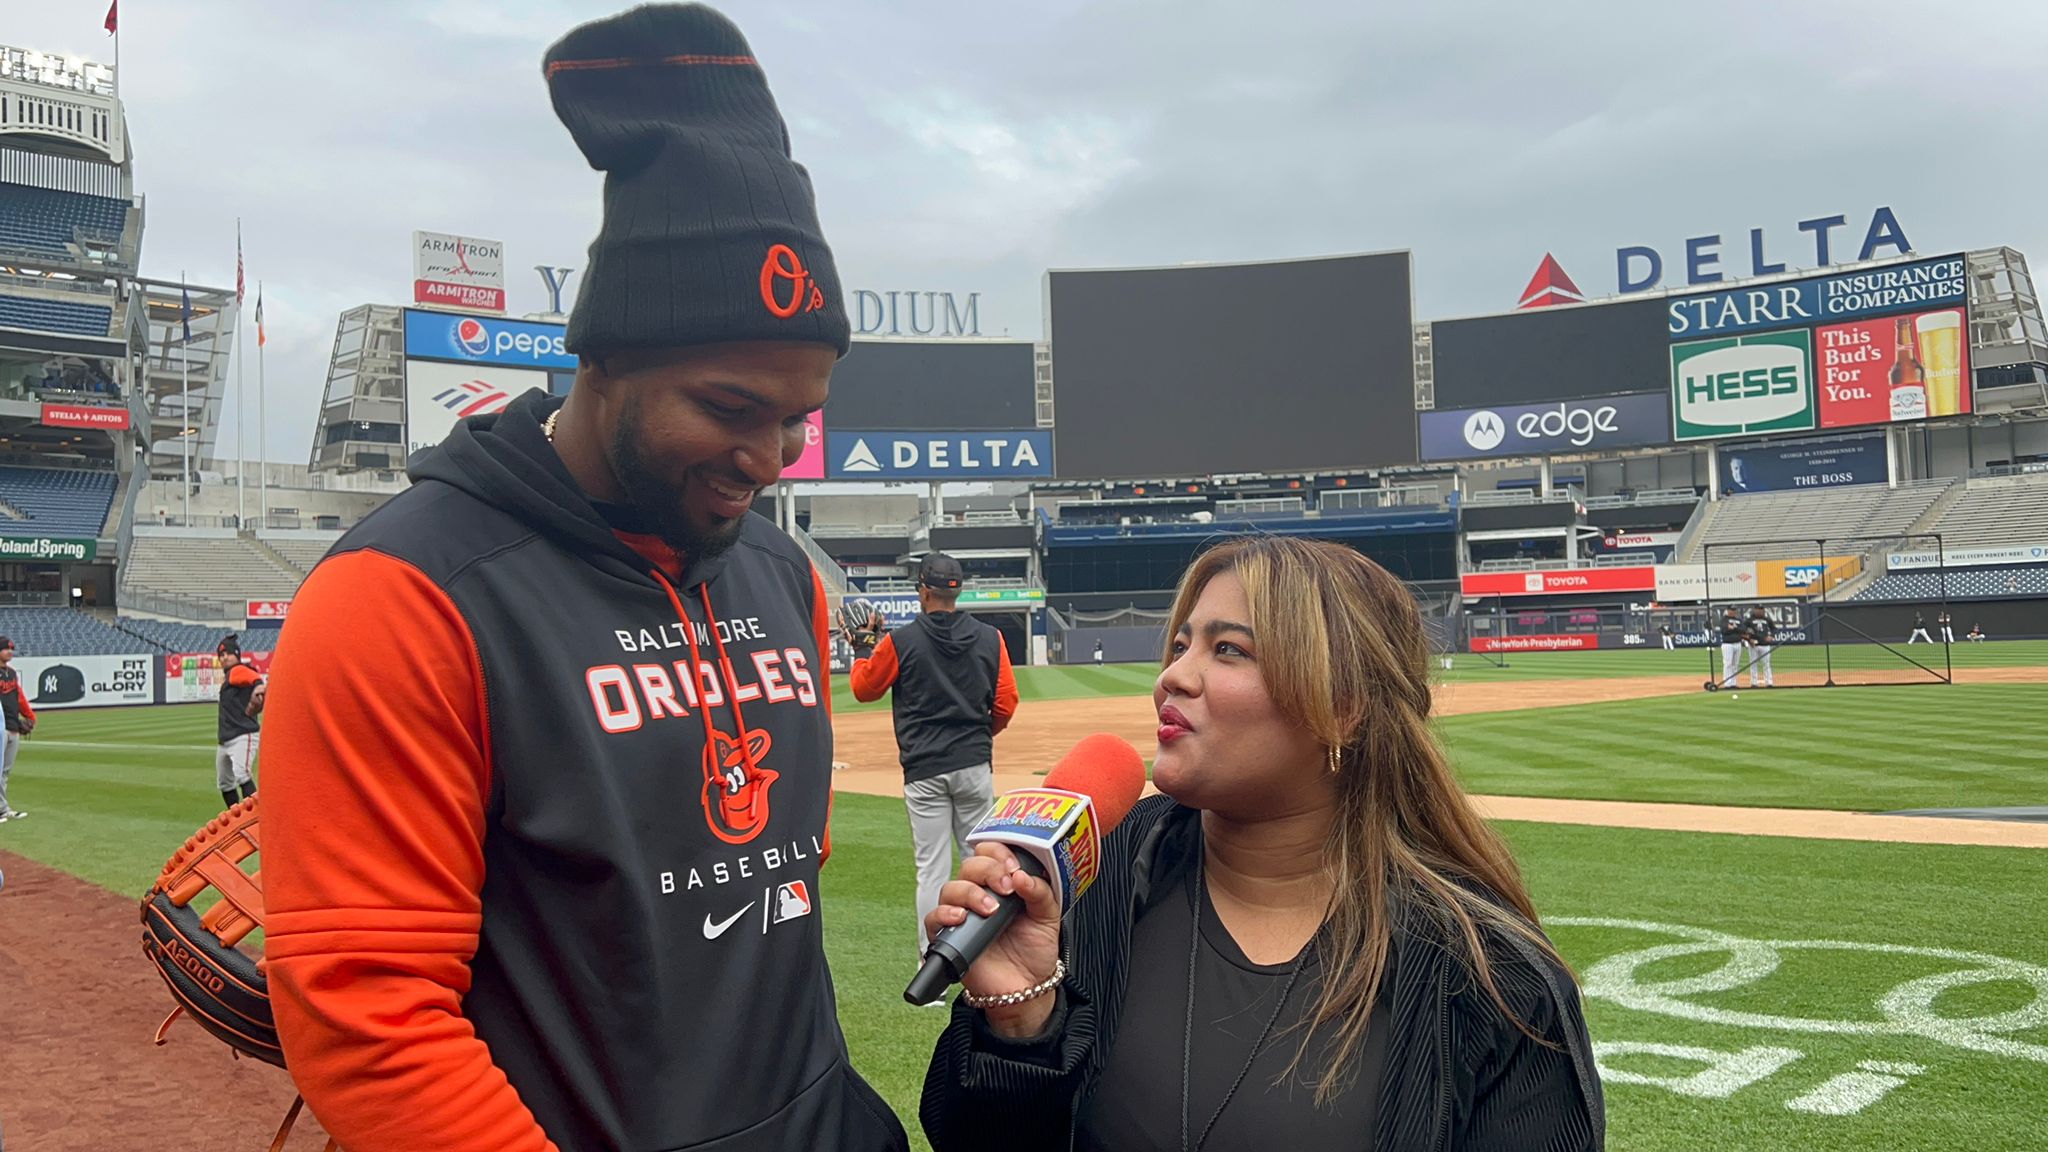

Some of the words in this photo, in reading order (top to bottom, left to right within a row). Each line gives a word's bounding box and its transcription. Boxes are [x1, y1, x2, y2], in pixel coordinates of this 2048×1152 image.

[422, 239, 499, 258] ARMITRON
[1616, 206, 1914, 294] DELTA
[760, 243, 825, 319] O's
[1827, 259, 1964, 298] INSURANCE
[427, 283, 498, 300] ARMITRON
[1827, 278, 1966, 315] COMPANIES
[1668, 286, 1812, 334] STARR
[495, 331, 566, 359] peps
[1822, 328, 1871, 348] This
[1824, 345, 1882, 366] Bud's
[1686, 366, 1798, 404] HESS
[1826, 367, 1861, 384] For
[1826, 382, 1872, 403] You.
[50, 411, 81, 421] STELLA
[90, 414, 122, 423] ARTOIS
[1516, 402, 1619, 447] edge
[893, 440, 1039, 468] DELTA
[1793, 475, 1818, 486] THE
[1822, 472, 1853, 483] BOSS
[40, 539, 85, 558] Spring
[1619, 536, 1653, 544] TOYOTA
[1547, 576, 1588, 586] TOYOTA
[1784, 570, 1819, 585] SAP
[873, 600, 921, 617] coupa
[1491, 638, 1583, 649] NewYork-Presbyterian
[123, 660, 146, 669] FIT
[114, 671, 146, 681] FOR
[92, 682, 145, 693] GLORY
[586, 648, 817, 733] ORIOLES
[994, 797, 1063, 819] NYC
[165, 938, 225, 994] A2000
